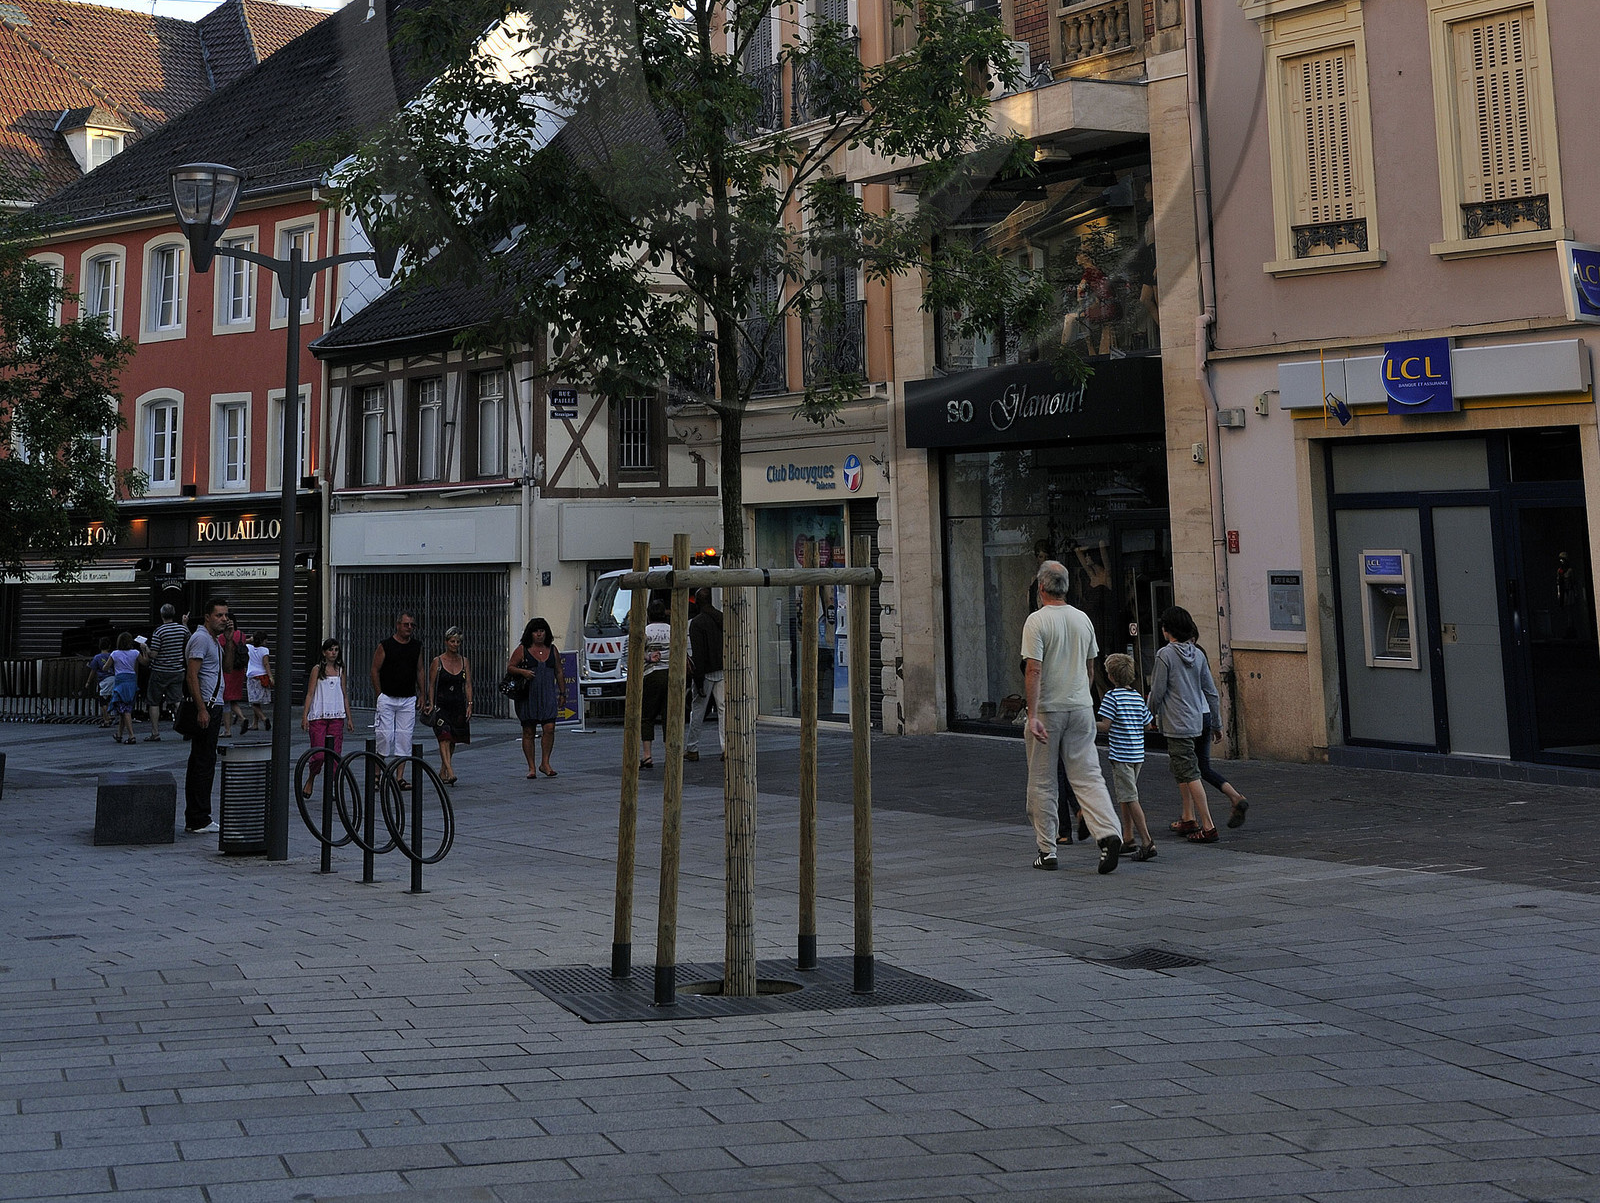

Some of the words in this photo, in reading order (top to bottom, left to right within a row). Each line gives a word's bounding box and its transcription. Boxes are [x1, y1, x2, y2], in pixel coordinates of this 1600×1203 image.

[1577, 262, 1600, 285] LC
[1386, 356, 1442, 381] LCL
[947, 399, 974, 423] SO
[989, 383, 1086, 431] Glamour!
[766, 464, 787, 483] Club
[788, 463, 835, 484] Bouygues
[197, 518, 282, 542] POULAILLO
